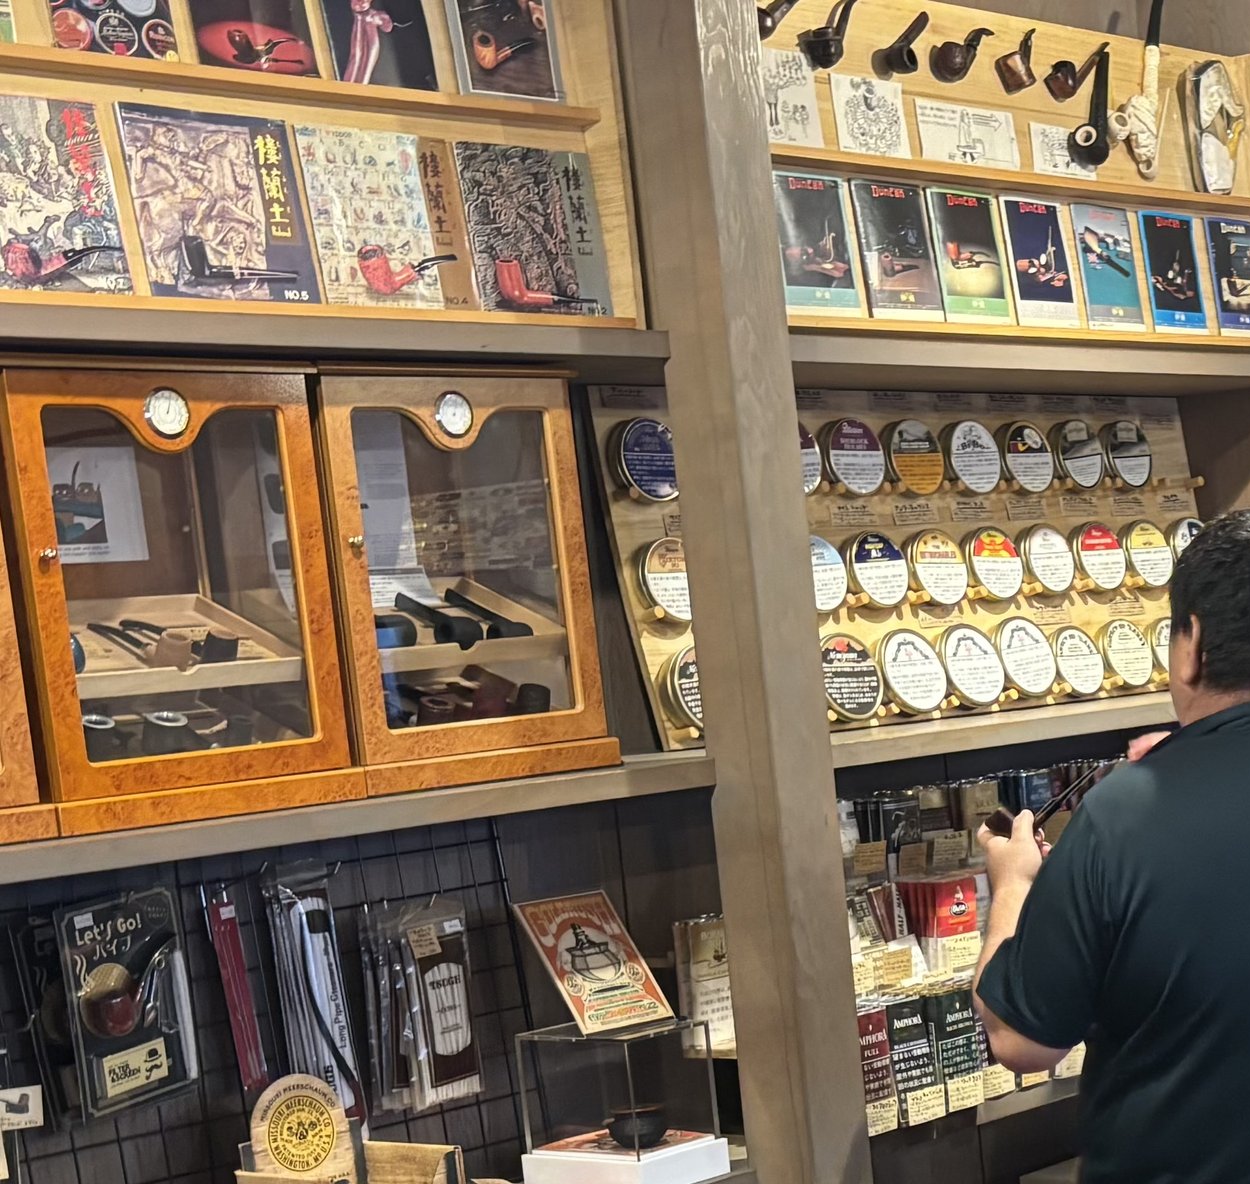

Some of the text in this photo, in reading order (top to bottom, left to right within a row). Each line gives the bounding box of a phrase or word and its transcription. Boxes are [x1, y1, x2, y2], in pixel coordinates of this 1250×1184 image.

[871, 185, 906, 198] Duncan
[1220, 222, 1247, 234] Duncan
[284, 289, 310, 301] NO.5
[75, 912, 142, 946] Let's Go!
[333, 1002, 346, 1025] Pipe
[893, 1013, 923, 1030] AMPHORA
[333, 1025, 348, 1049] Long
[859, 1028, 888, 1046] MPHORA
[270, 1108, 286, 1144] MISSOURI
